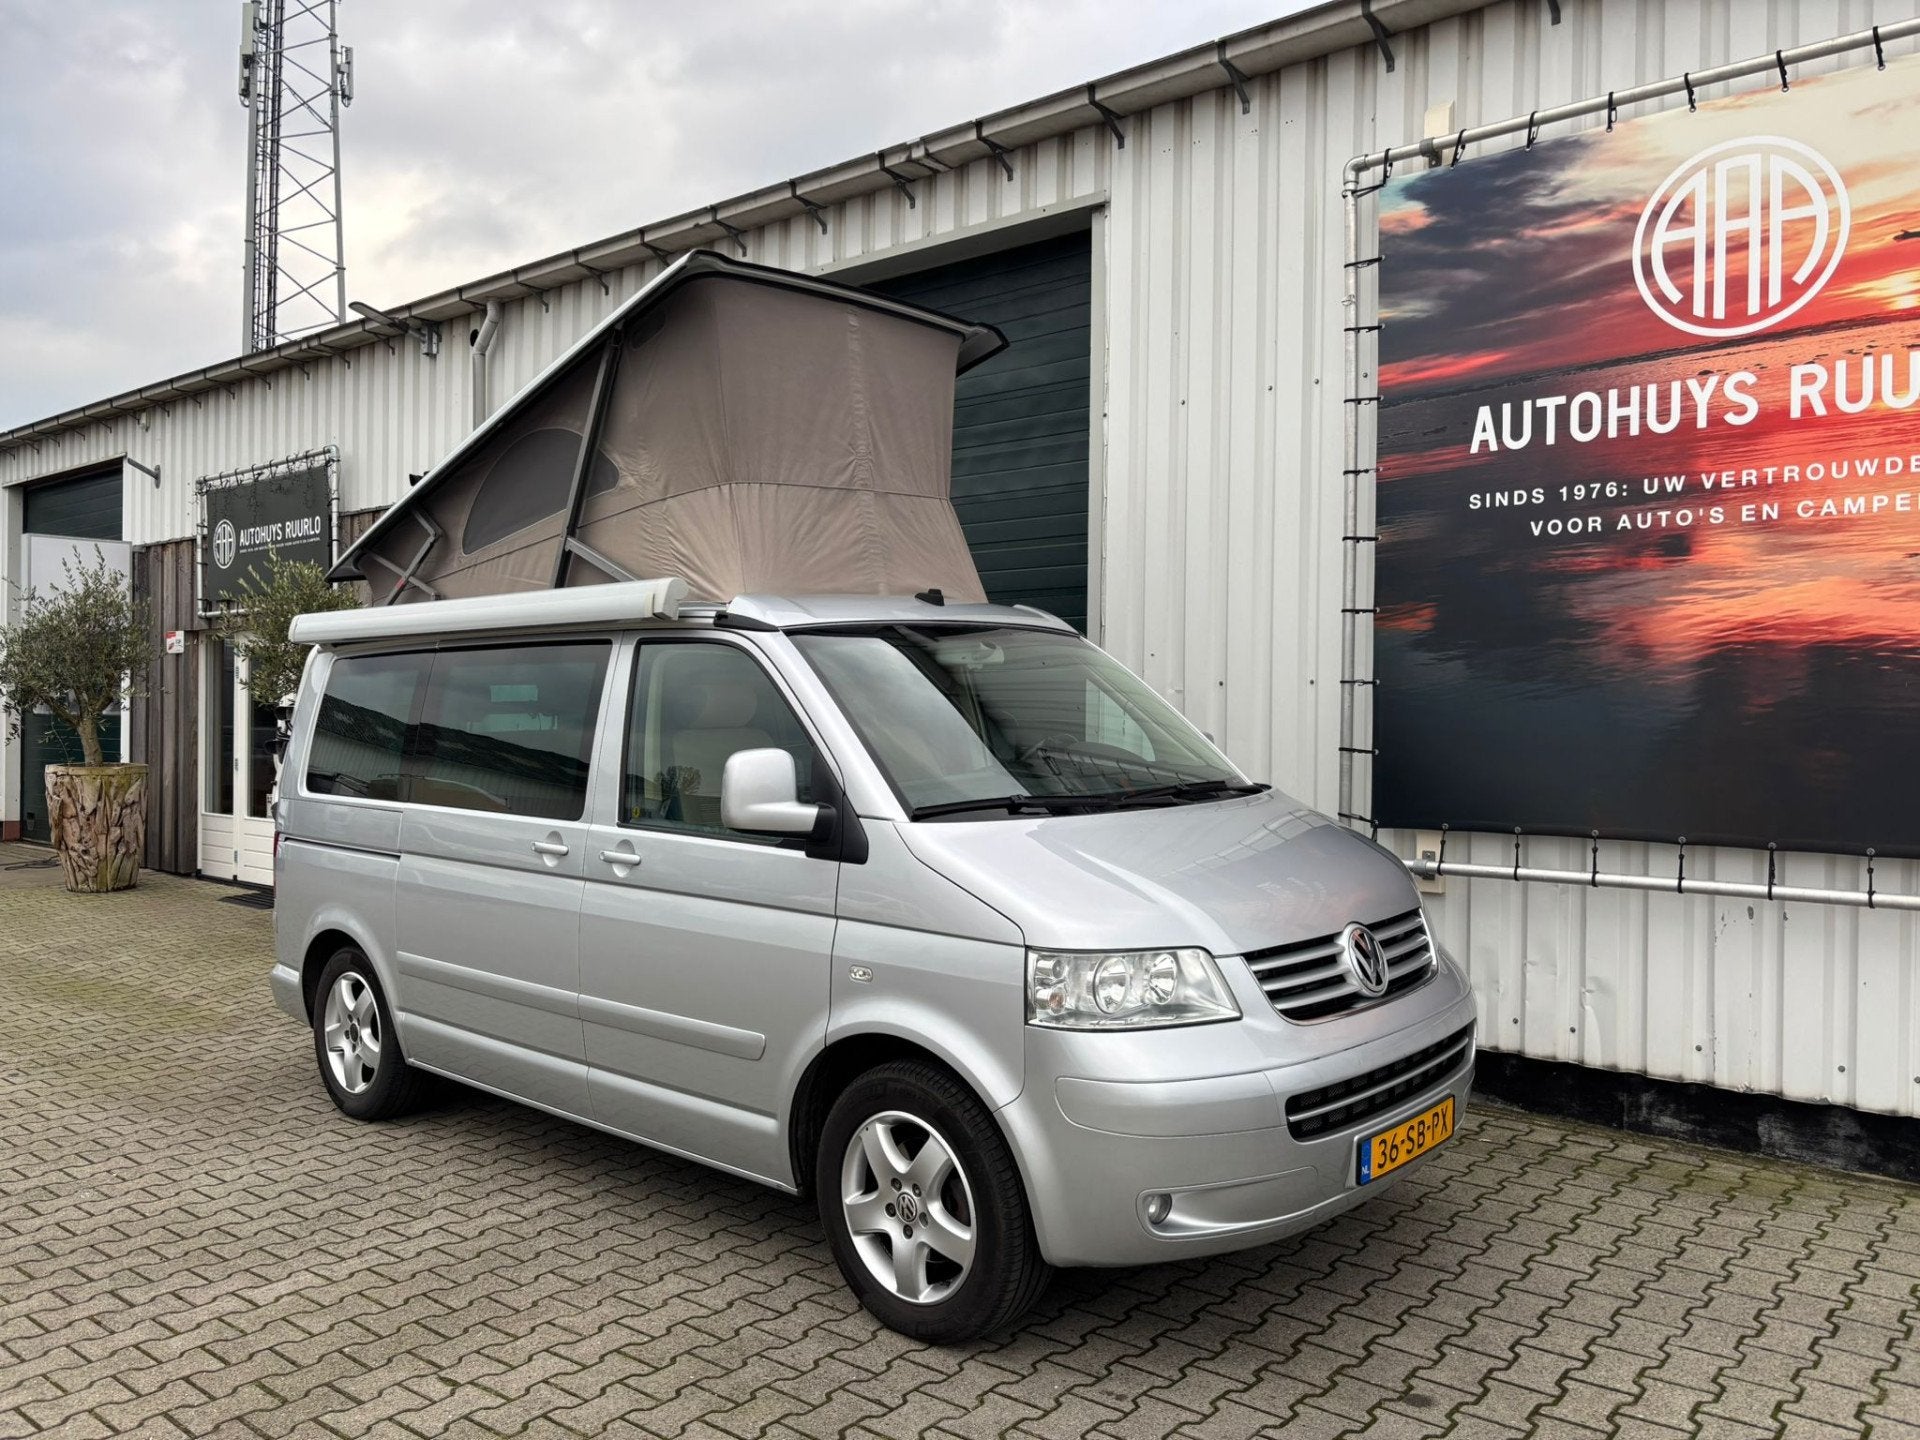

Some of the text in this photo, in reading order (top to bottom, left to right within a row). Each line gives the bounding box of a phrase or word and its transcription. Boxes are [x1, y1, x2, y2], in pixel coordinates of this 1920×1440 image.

[1469, 350, 1920, 454] AUTOHUYS RUU
[1469, 454, 1920, 510] SINDS 1976: UW VERTROUWDE
[239, 522, 283, 547] AUTOHUYS
[285, 515, 321, 539] RUURLO
[1530, 493, 1920, 536] VOOR AUTO'S EN CAMPE
[1377, 1105, 1449, 1170] 36-SB-PX
[1361, 1164, 1370, 1176] NL
